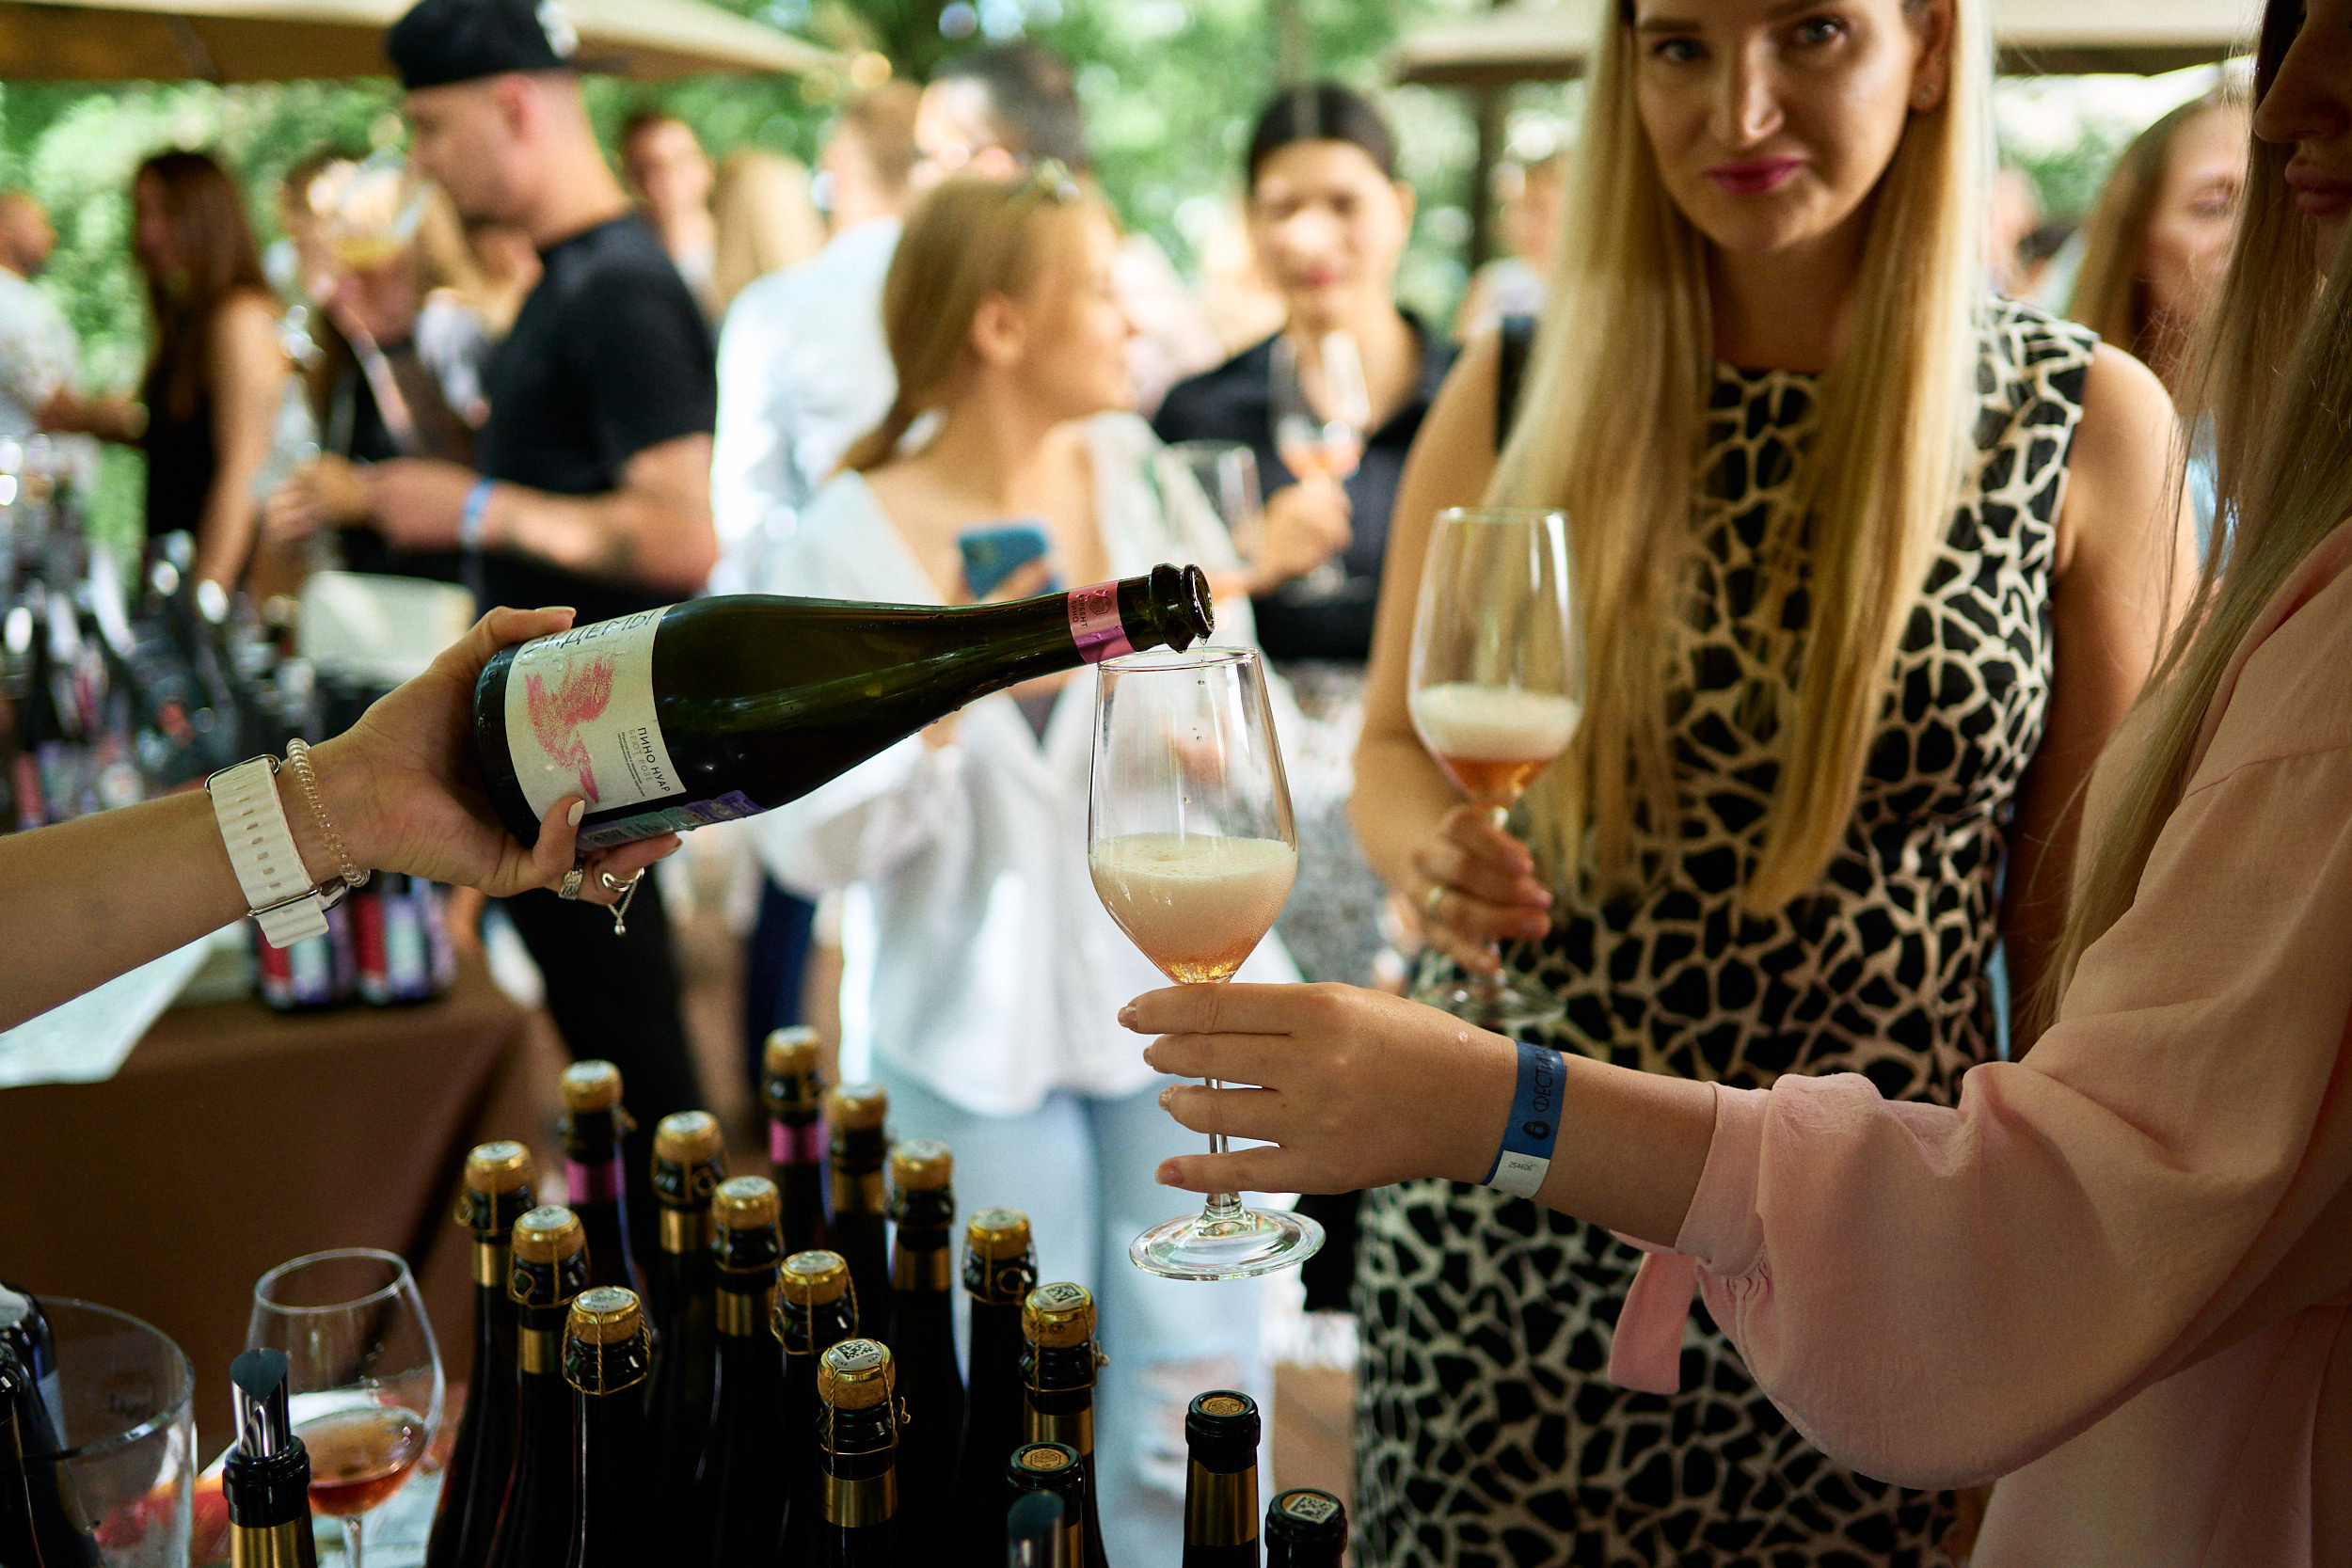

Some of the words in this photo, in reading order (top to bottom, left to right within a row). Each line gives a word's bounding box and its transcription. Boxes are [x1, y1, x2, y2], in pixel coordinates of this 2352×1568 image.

[1071, 600, 1079, 623] ВИНО
[628, 729, 642, 755] БРЮТ
[638, 759, 653, 782] РОЗЕ
[637, 727, 656, 764] ПИНО
[651, 766, 671, 792] НУАР
